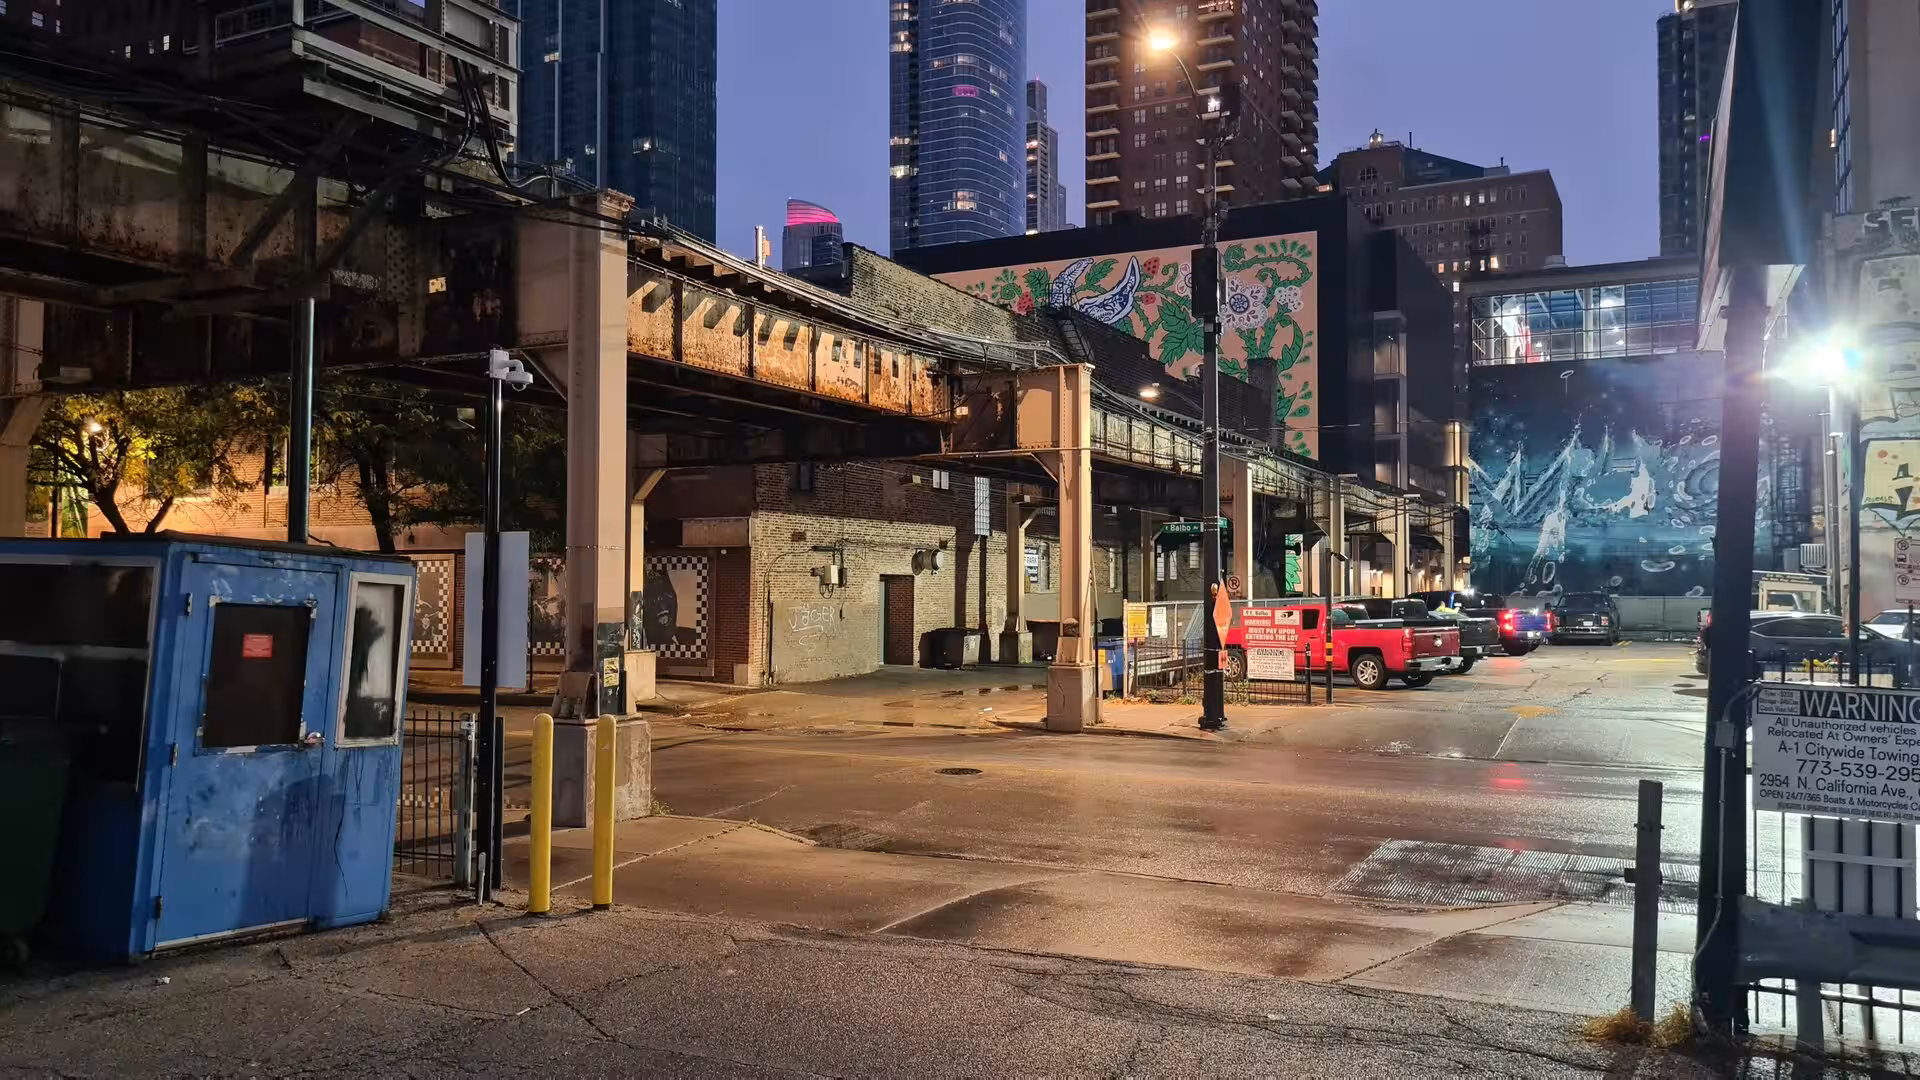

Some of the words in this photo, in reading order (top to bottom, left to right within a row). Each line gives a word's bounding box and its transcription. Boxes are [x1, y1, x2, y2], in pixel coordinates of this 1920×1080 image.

[1170, 524, 1192, 532] Balbo
[1245, 633, 1276, 641] ENTERING
[1767, 726, 1824, 740] Relocated
[1826, 730, 1840, 741] At
[1774, 717, 1789, 728] All
[1791, 718, 1867, 733] Unauthorized
[1869, 722, 1917, 736] vehicles
[1777, 740, 1800, 754] A-1
[1804, 742, 1865, 760] Citywide
[1759, 772, 1790, 788] 2954
[1797, 776, 1811, 790] N.
[1815, 777, 1877, 796] California
[1880, 784, 1914, 801] Ave.,
[1759, 788, 1785, 800] OPEN
[1785, 790, 1821, 803] 24/7/365
[1823, 794, 1846, 805] Boats
[1847, 796, 1855, 806] &
[1857, 798, 1909, 811] Motorcycles
